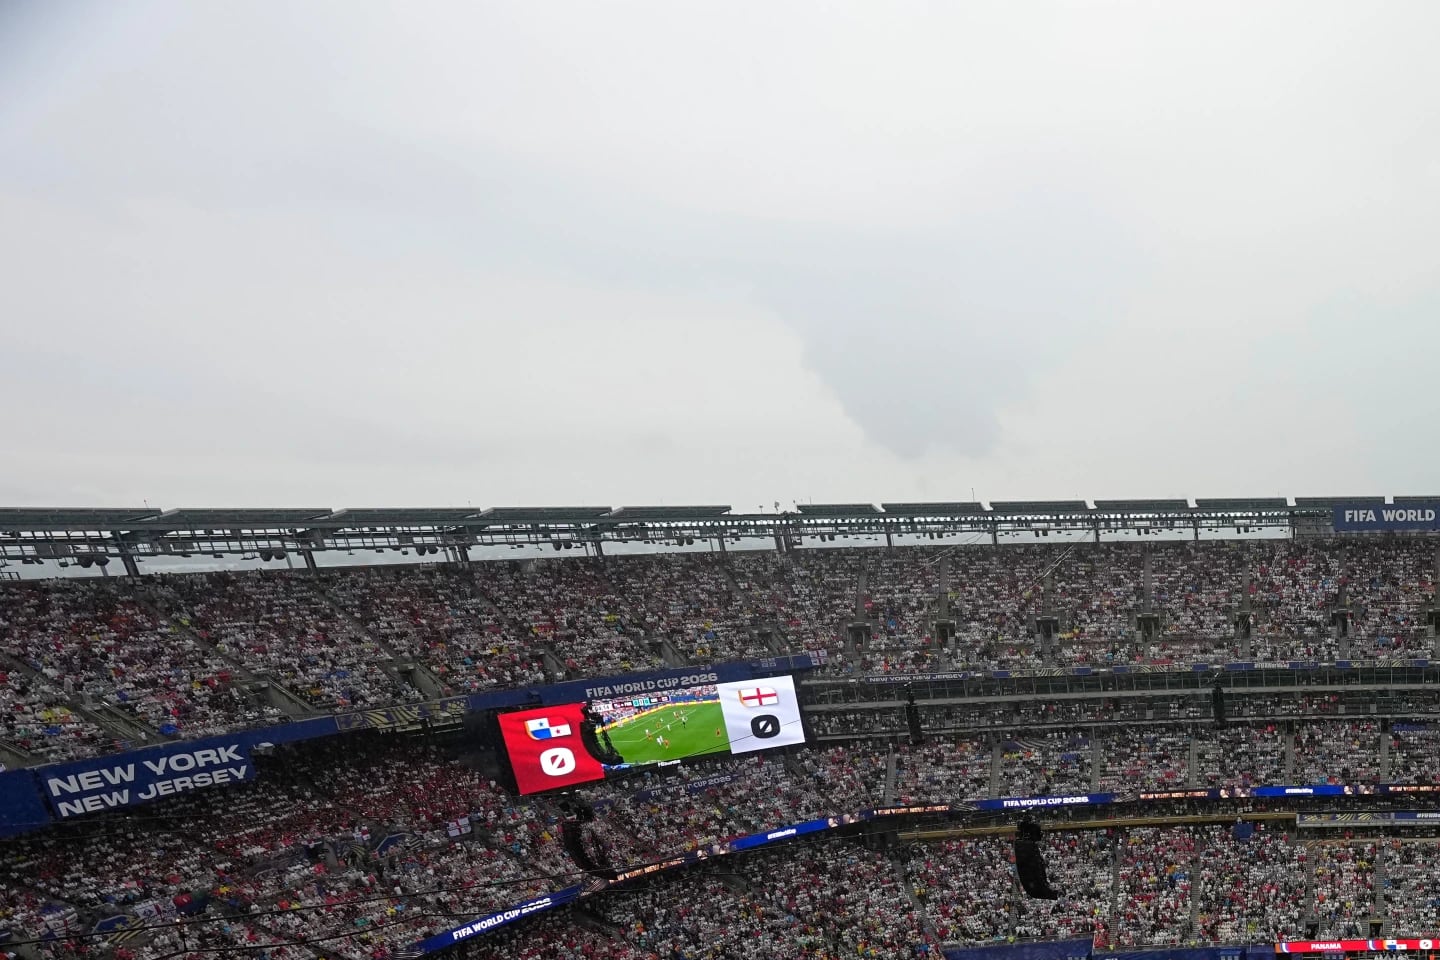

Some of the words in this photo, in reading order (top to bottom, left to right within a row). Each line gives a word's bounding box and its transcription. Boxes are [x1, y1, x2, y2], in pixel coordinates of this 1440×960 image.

[1344, 509, 1376, 522] FIFA
[1382, 509, 1435, 522] WORLD
[586, 687, 612, 698] FIFA
[613, 681, 656, 694] WORLD
[657, 677, 679, 689] CUP
[680, 673, 718, 686] 2026
[47, 763, 135, 797] NEW
[142, 744, 244, 776] YORK
[708, 775, 732, 785] 2026
[57, 789, 129, 817] NEW
[138, 765, 247, 800] JERSEY
[1003, 800, 1021, 808] FIFA
[1020, 798, 1047, 807] WORLD
[1047, 797, 1063, 805] CUP
[1062, 796, 1089, 804] 2026
[453, 924, 474, 940] FIFA
[472, 914, 504, 934] WORLD
[503, 908, 522, 921] CUP
[1310, 943, 1342, 951] PANAMA
